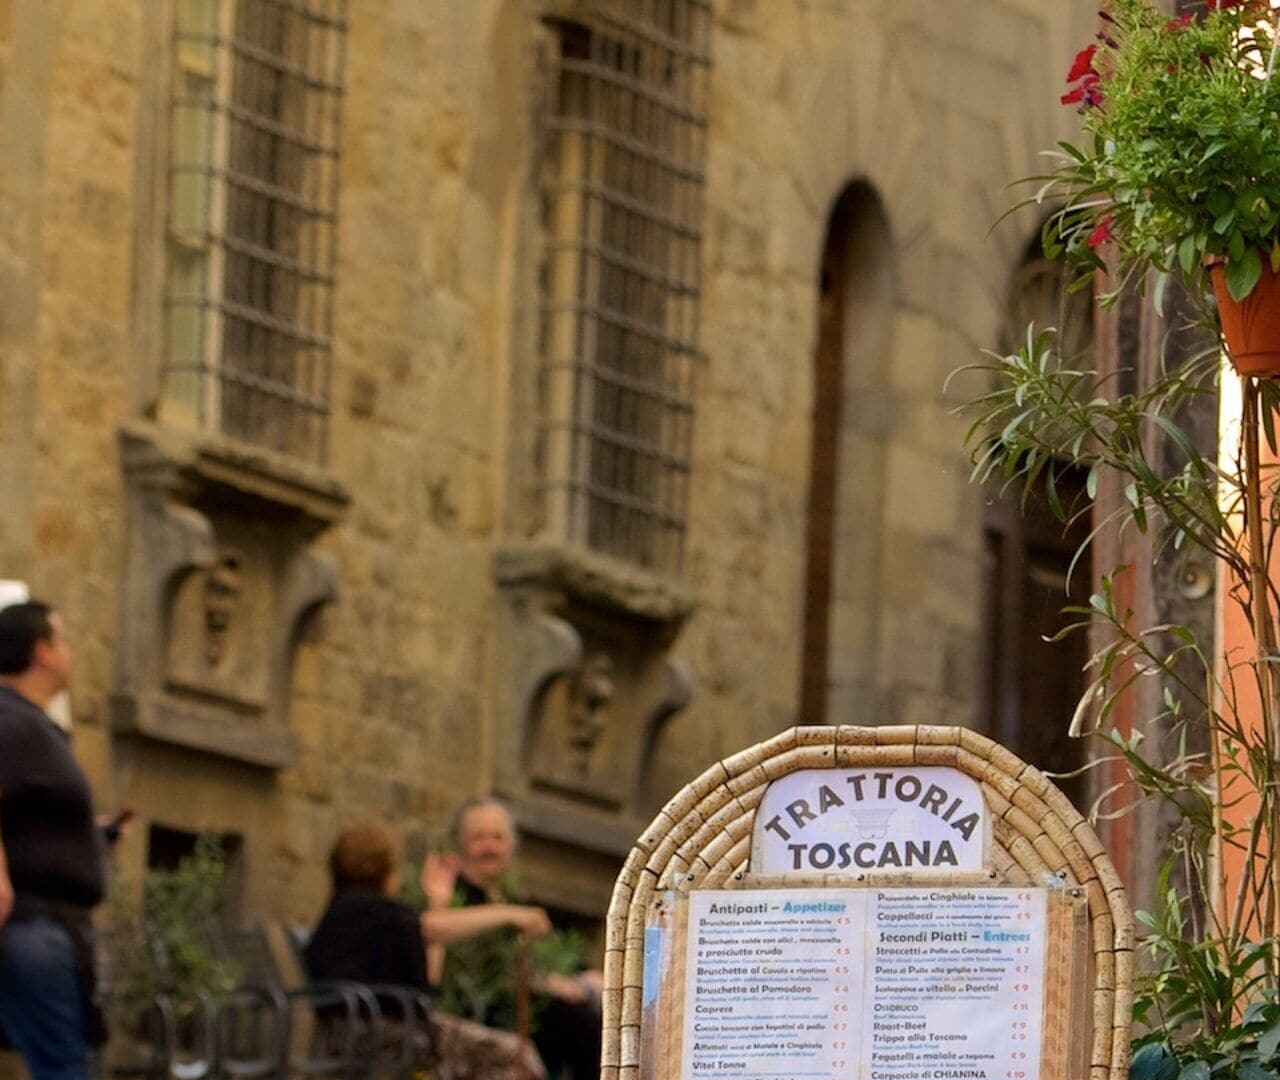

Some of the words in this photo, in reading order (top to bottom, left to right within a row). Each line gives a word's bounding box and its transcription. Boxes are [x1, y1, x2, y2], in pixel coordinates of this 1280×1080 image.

[764, 773, 980, 841] TRATTORIA
[788, 840, 958, 869] TOSCANA
[709, 903, 767, 914] Antipasti
[783, 902, 846, 913] Appetizer
[880, 932, 927, 942] Secondi
[931, 932, 967, 942] Piatti
[984, 931, 1030, 942] Entrees
[695, 1005, 733, 1014] Caprese
[873, 1022, 926, 1031] Roast-Beef
[873, 1034, 905, 1043] Trippa
[908, 1034, 926, 1042] alla
[693, 1062, 715, 1070] Vitel
